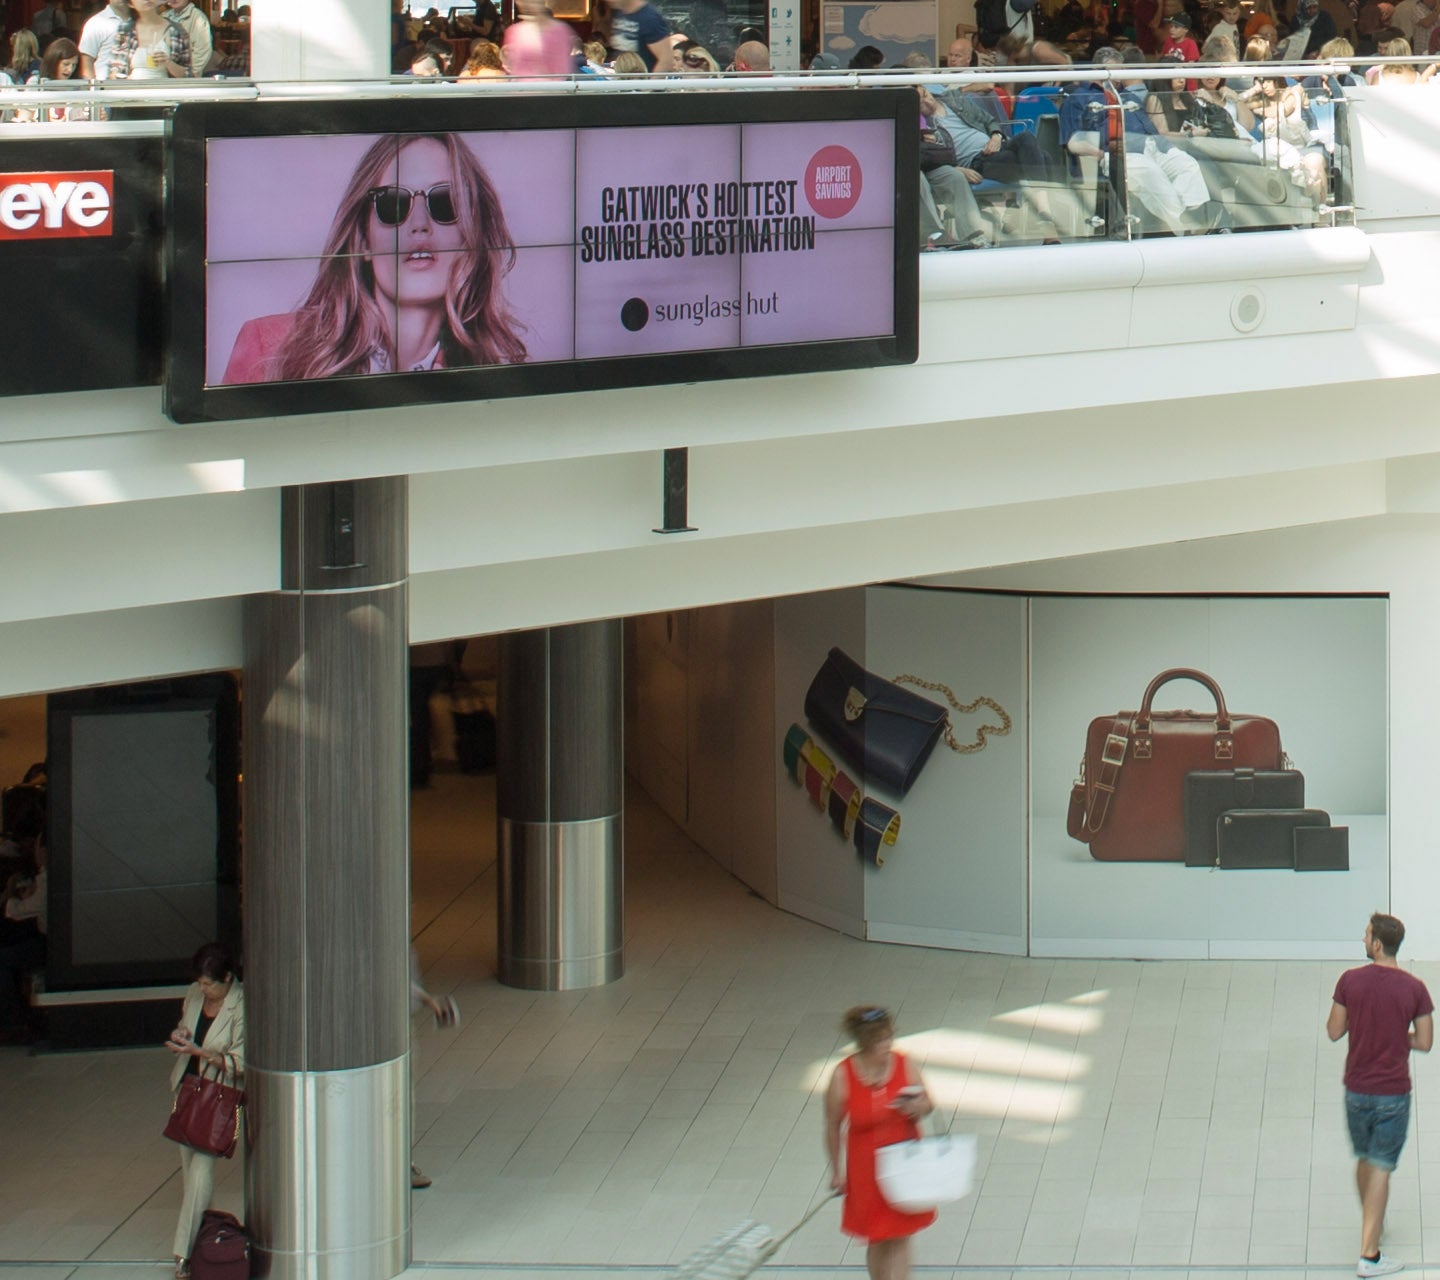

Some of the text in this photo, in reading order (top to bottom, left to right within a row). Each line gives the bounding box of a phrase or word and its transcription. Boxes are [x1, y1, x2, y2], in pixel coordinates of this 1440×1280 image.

[815, 182, 852, 200] SAVINGS
[816, 165, 851, 183] AIRPORT
[601, 180, 798, 223] GATWICK'S HOTTEST
[581, 216, 816, 263] SUNGLASS DESTINATION
[655, 291, 780, 327] sunglass hut
